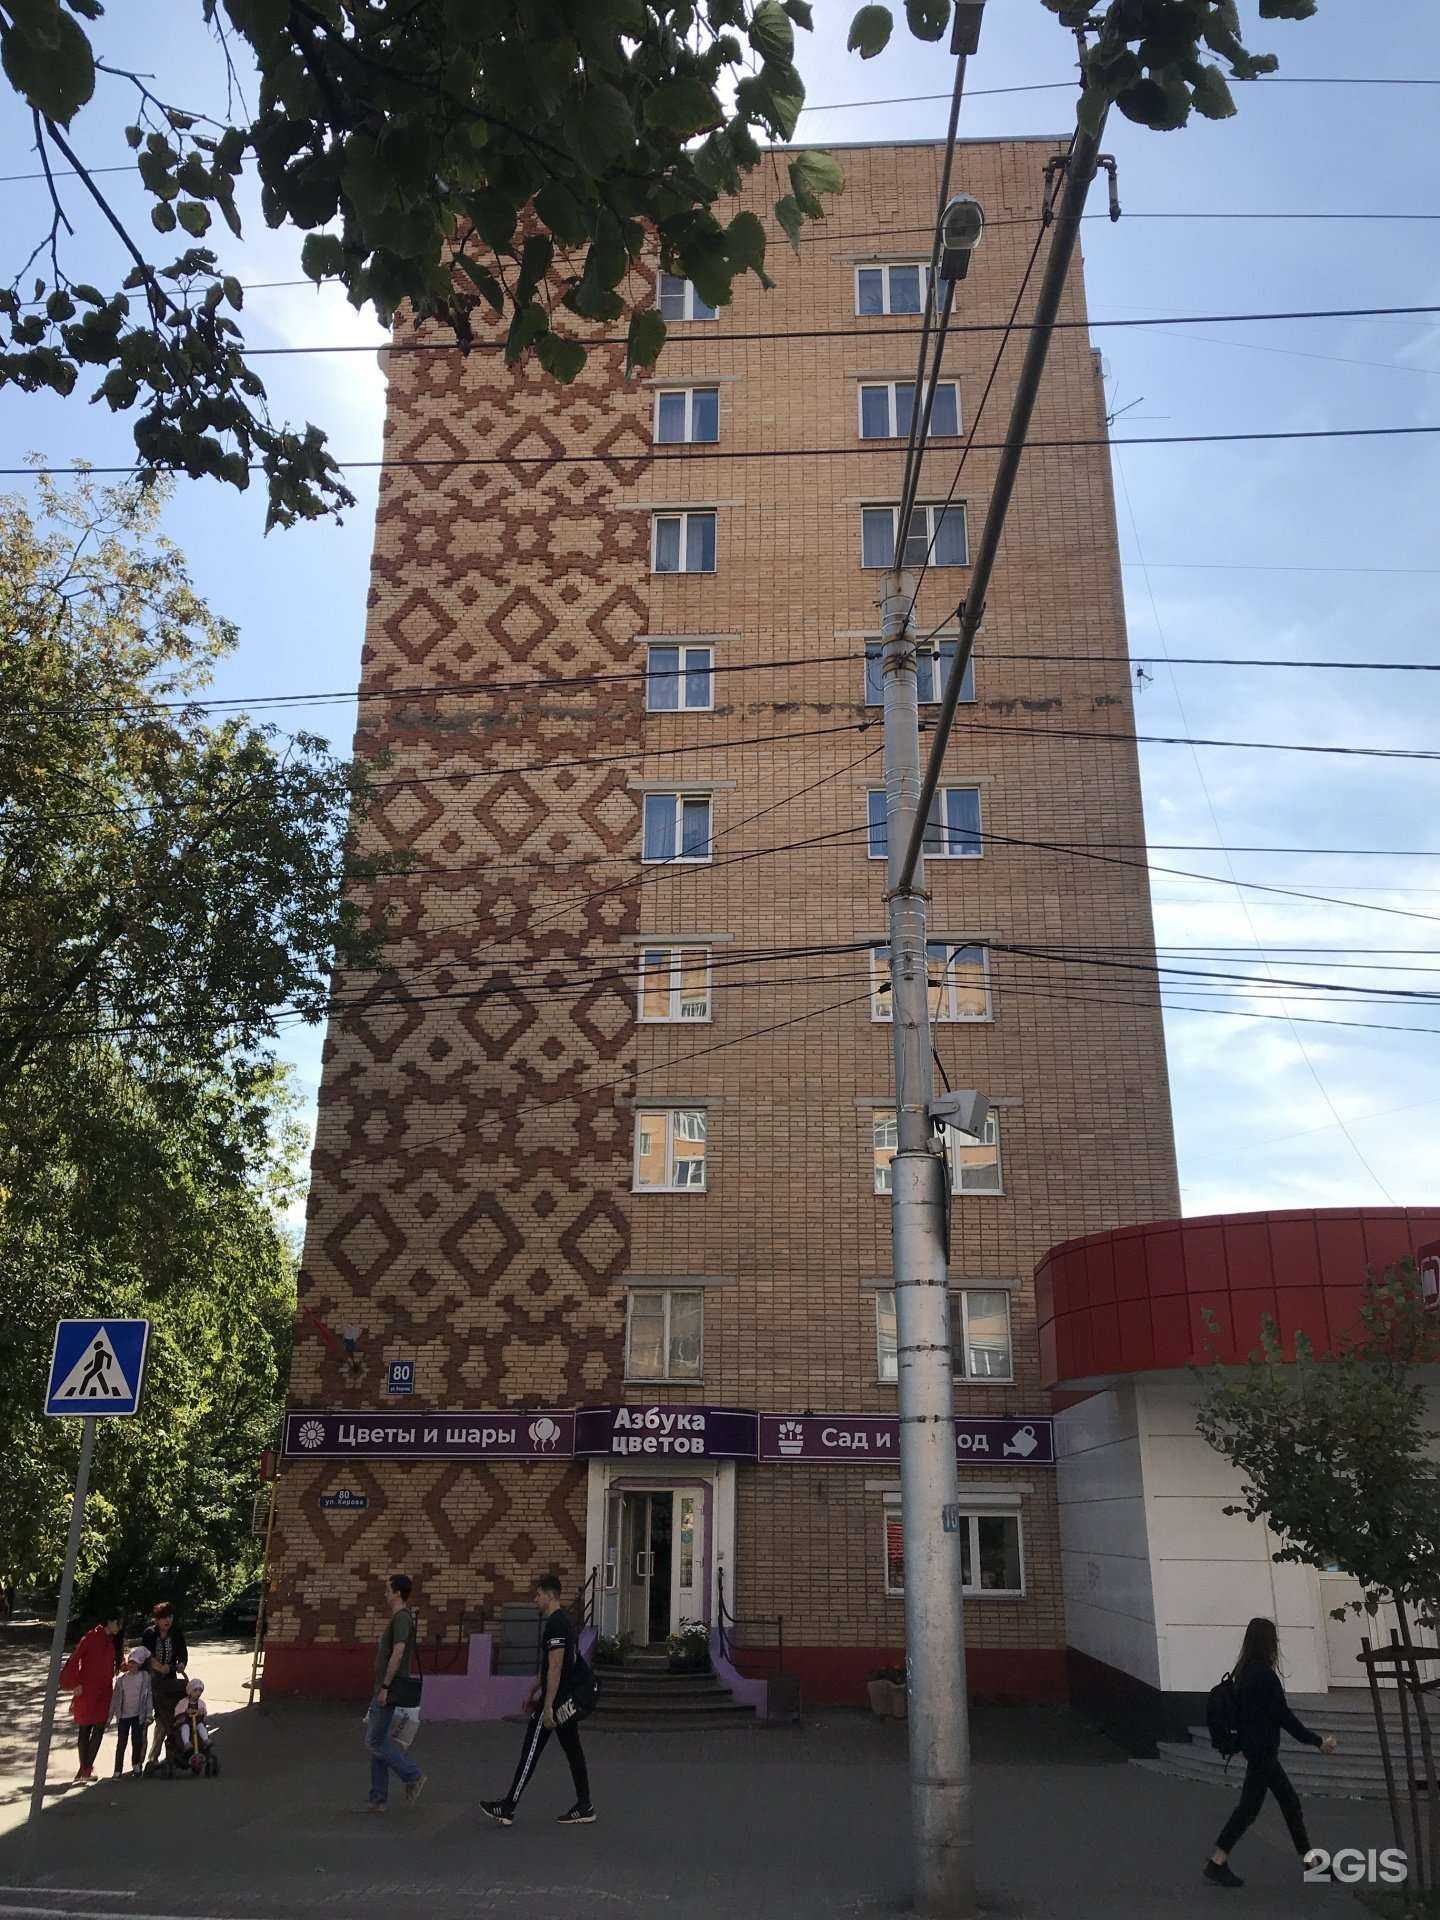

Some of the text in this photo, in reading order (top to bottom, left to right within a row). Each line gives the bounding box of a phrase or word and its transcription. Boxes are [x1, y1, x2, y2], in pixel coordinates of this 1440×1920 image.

[393, 1365, 410, 1380] 80
[613, 1406, 706, 1434] Азбука
[337, 1424, 516, 1448] Цветы и шары
[612, 1436, 705, 1455] цветов
[821, 1427, 869, 1450] Сад
[876, 1432, 891, 1448] и
[338, 1490, 350, 1499] 80
